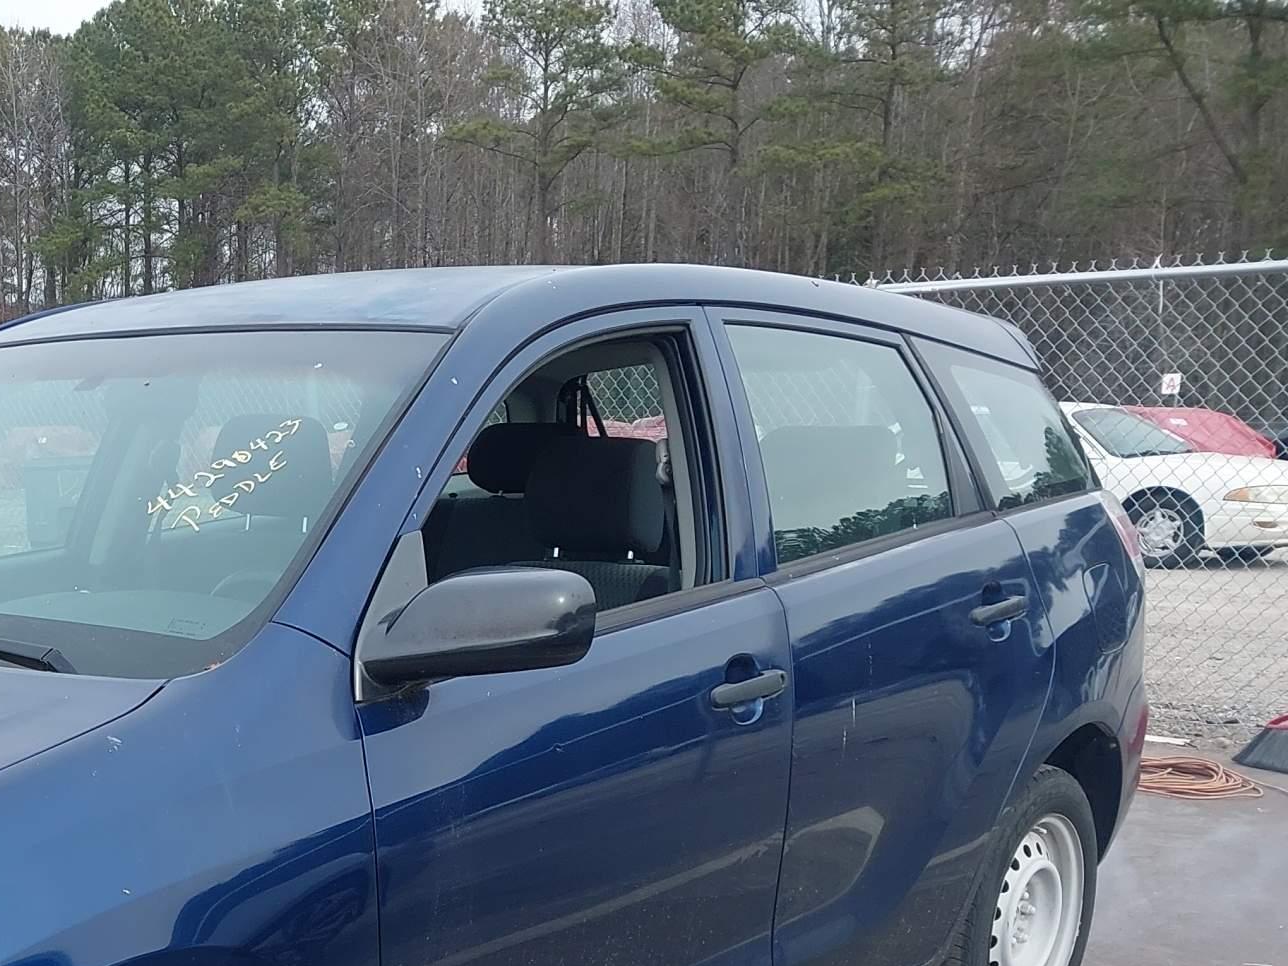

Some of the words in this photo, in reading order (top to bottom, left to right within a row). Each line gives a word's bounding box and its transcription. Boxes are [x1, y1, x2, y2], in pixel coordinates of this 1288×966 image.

[1166, 376, 1177, 392] A
[147, 417, 303, 515] 44290423
[170, 450, 287, 532] PEDDLE
